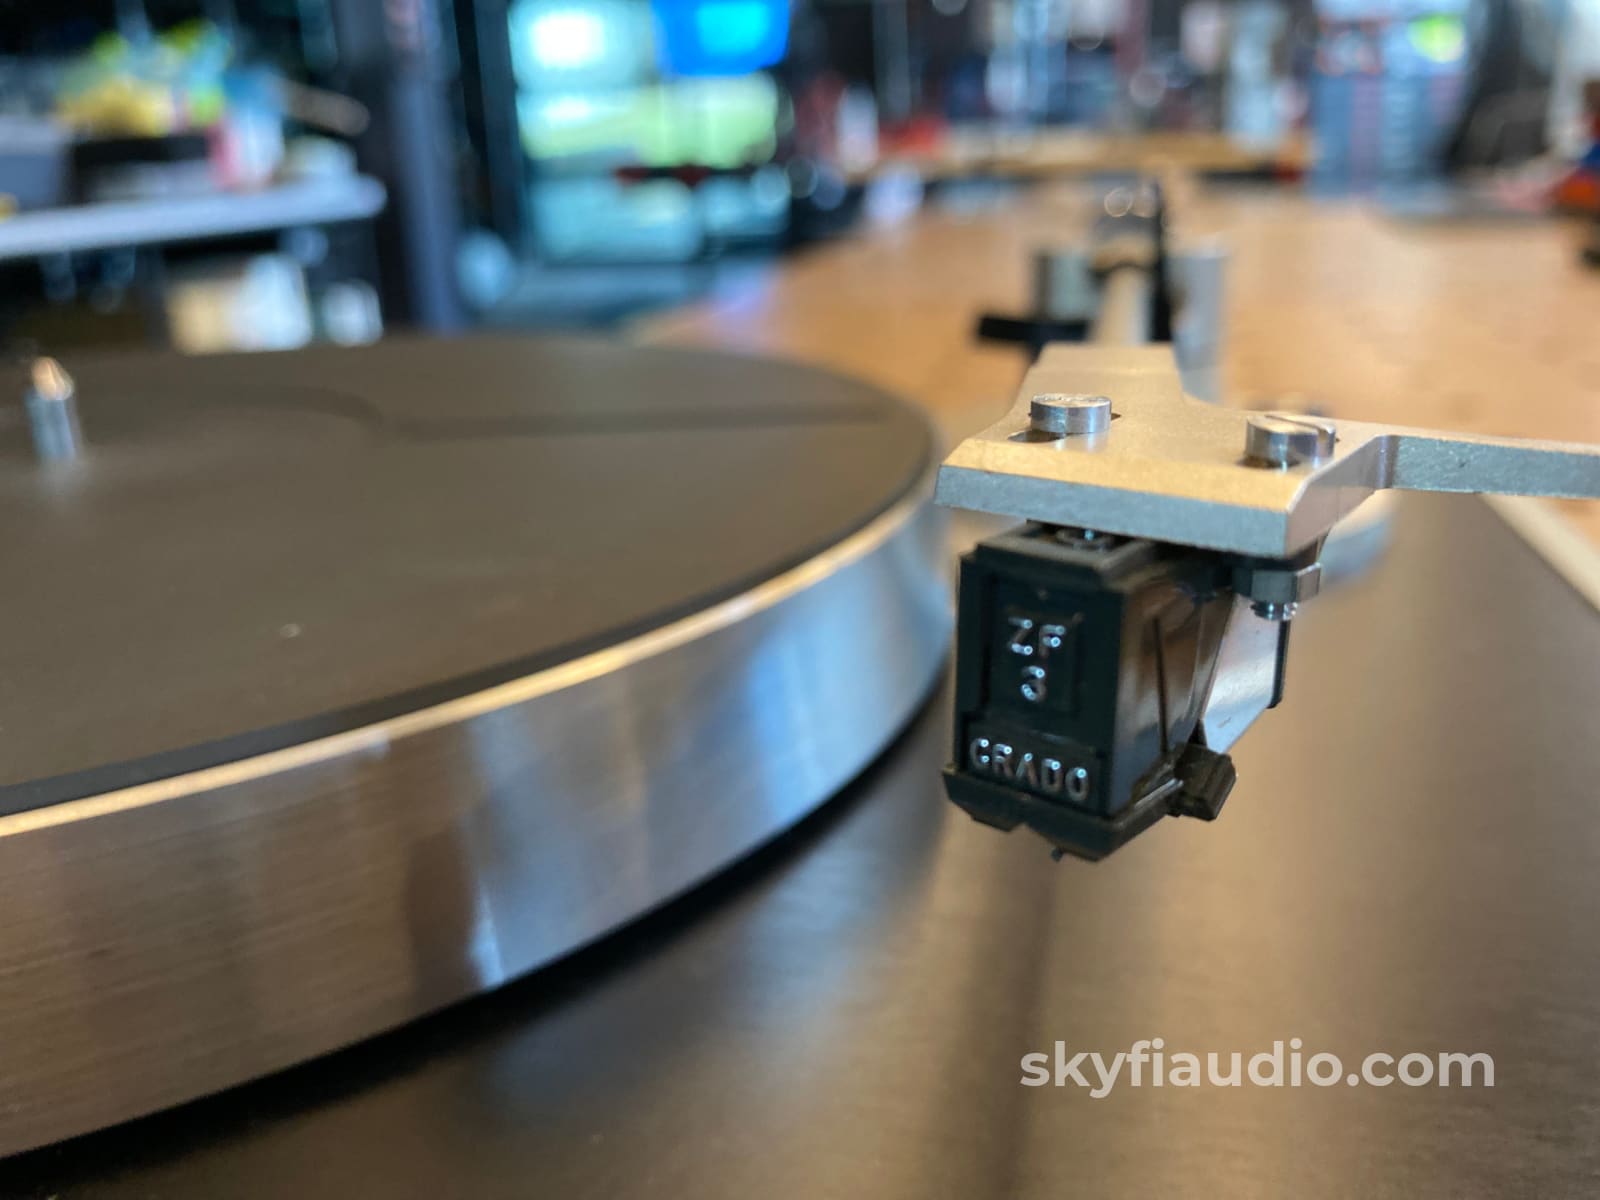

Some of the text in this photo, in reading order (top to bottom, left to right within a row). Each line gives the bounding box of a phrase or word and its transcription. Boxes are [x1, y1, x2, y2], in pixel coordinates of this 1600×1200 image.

[1007, 615, 1067, 658] ZF
[1020, 664, 1047, 702] 3
[969, 737, 1088, 800] GRADO
